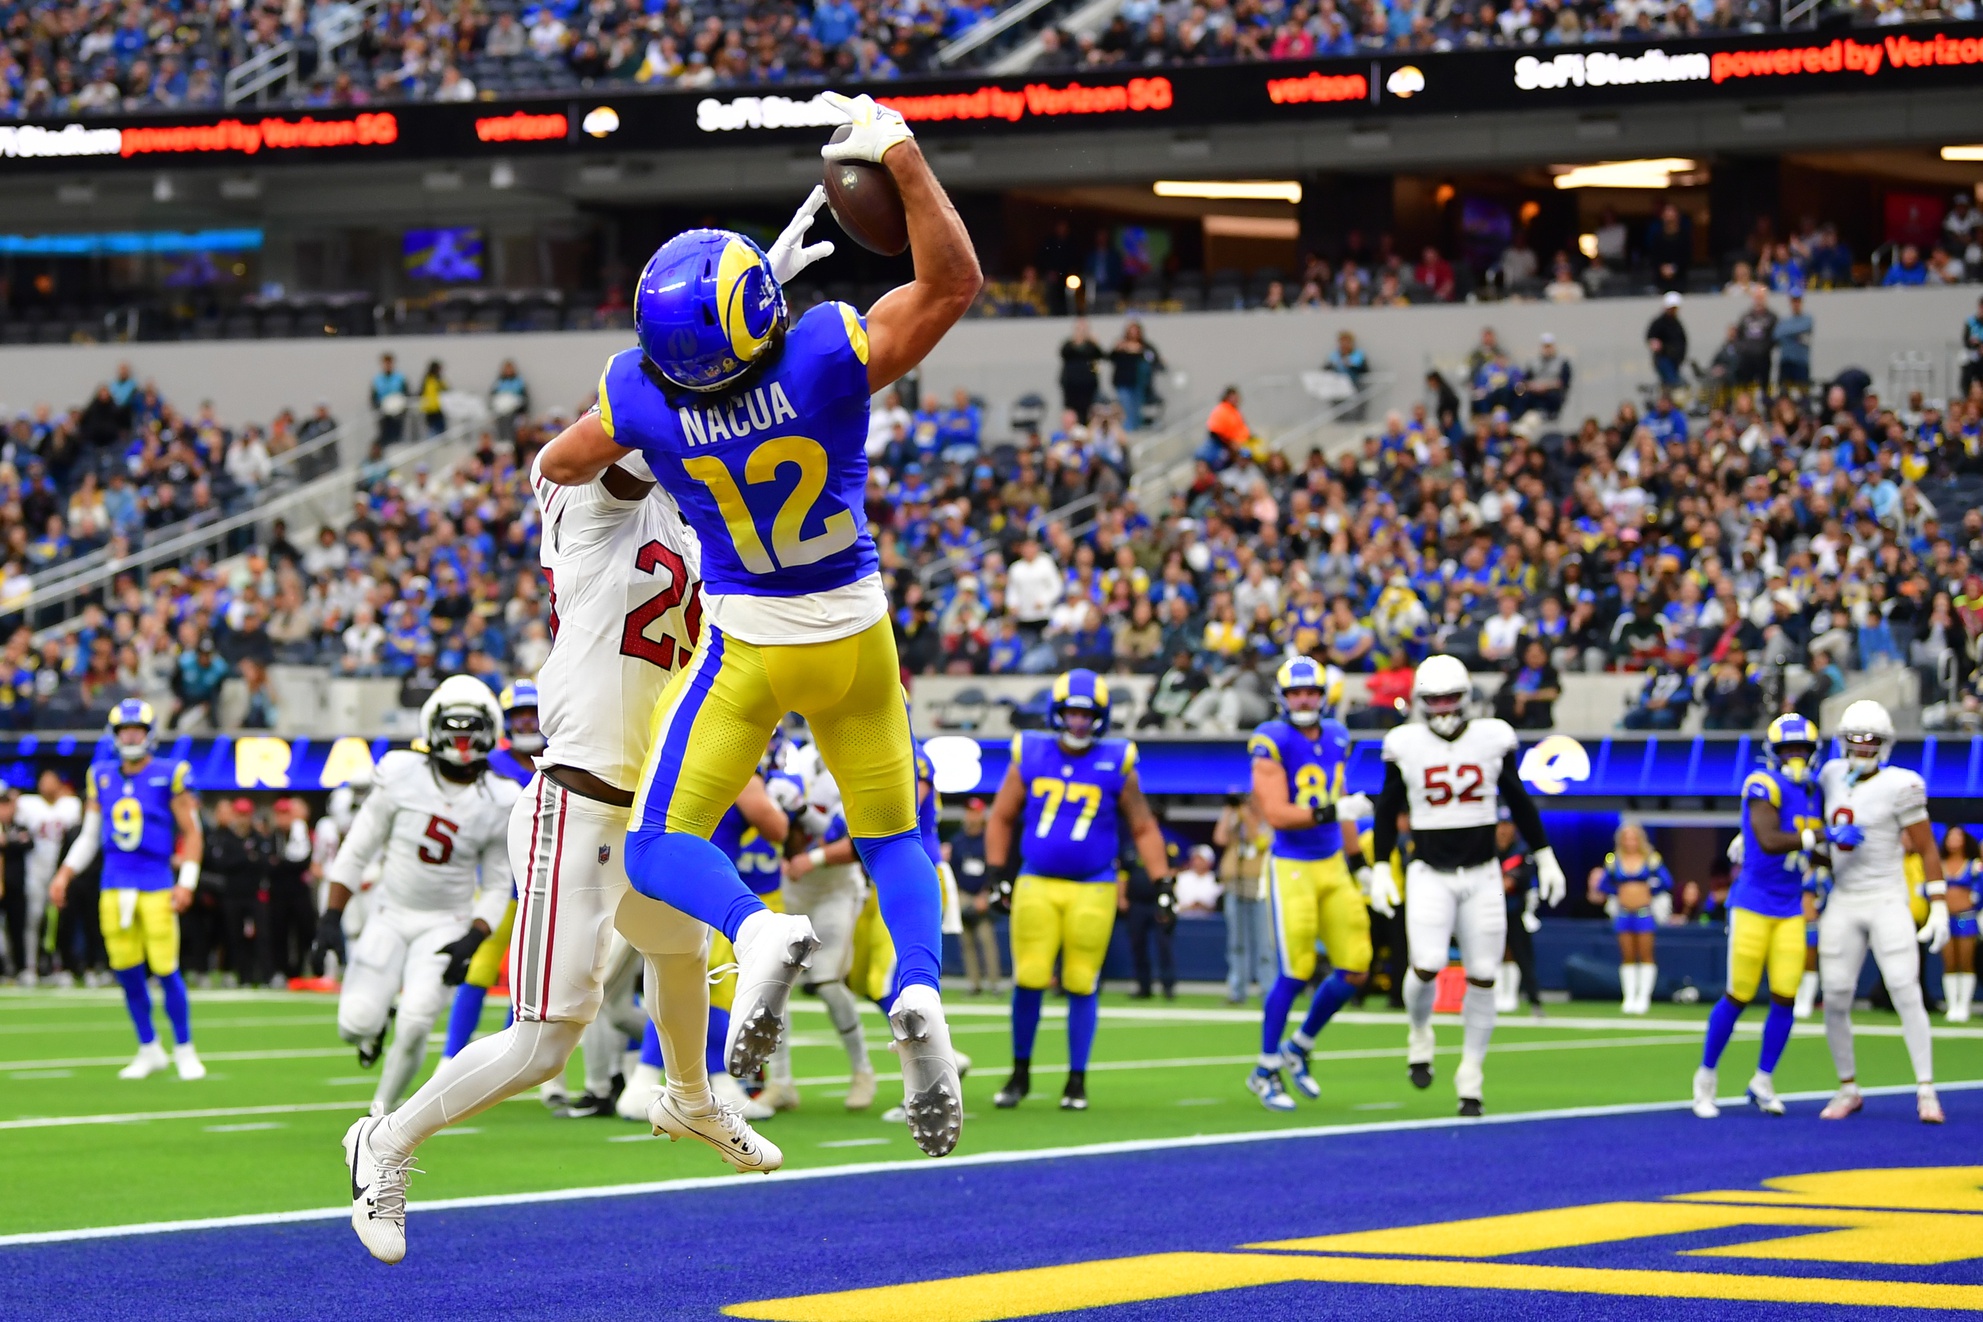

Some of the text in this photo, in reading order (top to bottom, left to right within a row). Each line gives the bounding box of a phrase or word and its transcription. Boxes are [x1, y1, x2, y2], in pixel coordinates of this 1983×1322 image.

[1514, 33, 1983, 90] SoFi Stadium powered by Verizo
[990, 87, 1025, 121] by
[1024, 82, 1127, 115] Verizon
[1267, 71, 1367, 104] verizon
[120, 119, 230, 158] powered
[230, 119, 261, 154] by
[259, 116, 355, 148] Verizon
[475, 110, 568, 141] verizon
[678, 381, 798, 447] NACUA
[681, 436, 858, 574] 12
[1031, 776, 1102, 842] 77
[1425, 764, 1484, 806] 52
[111, 797, 144, 852] 9
[418, 814, 459, 865] 5
